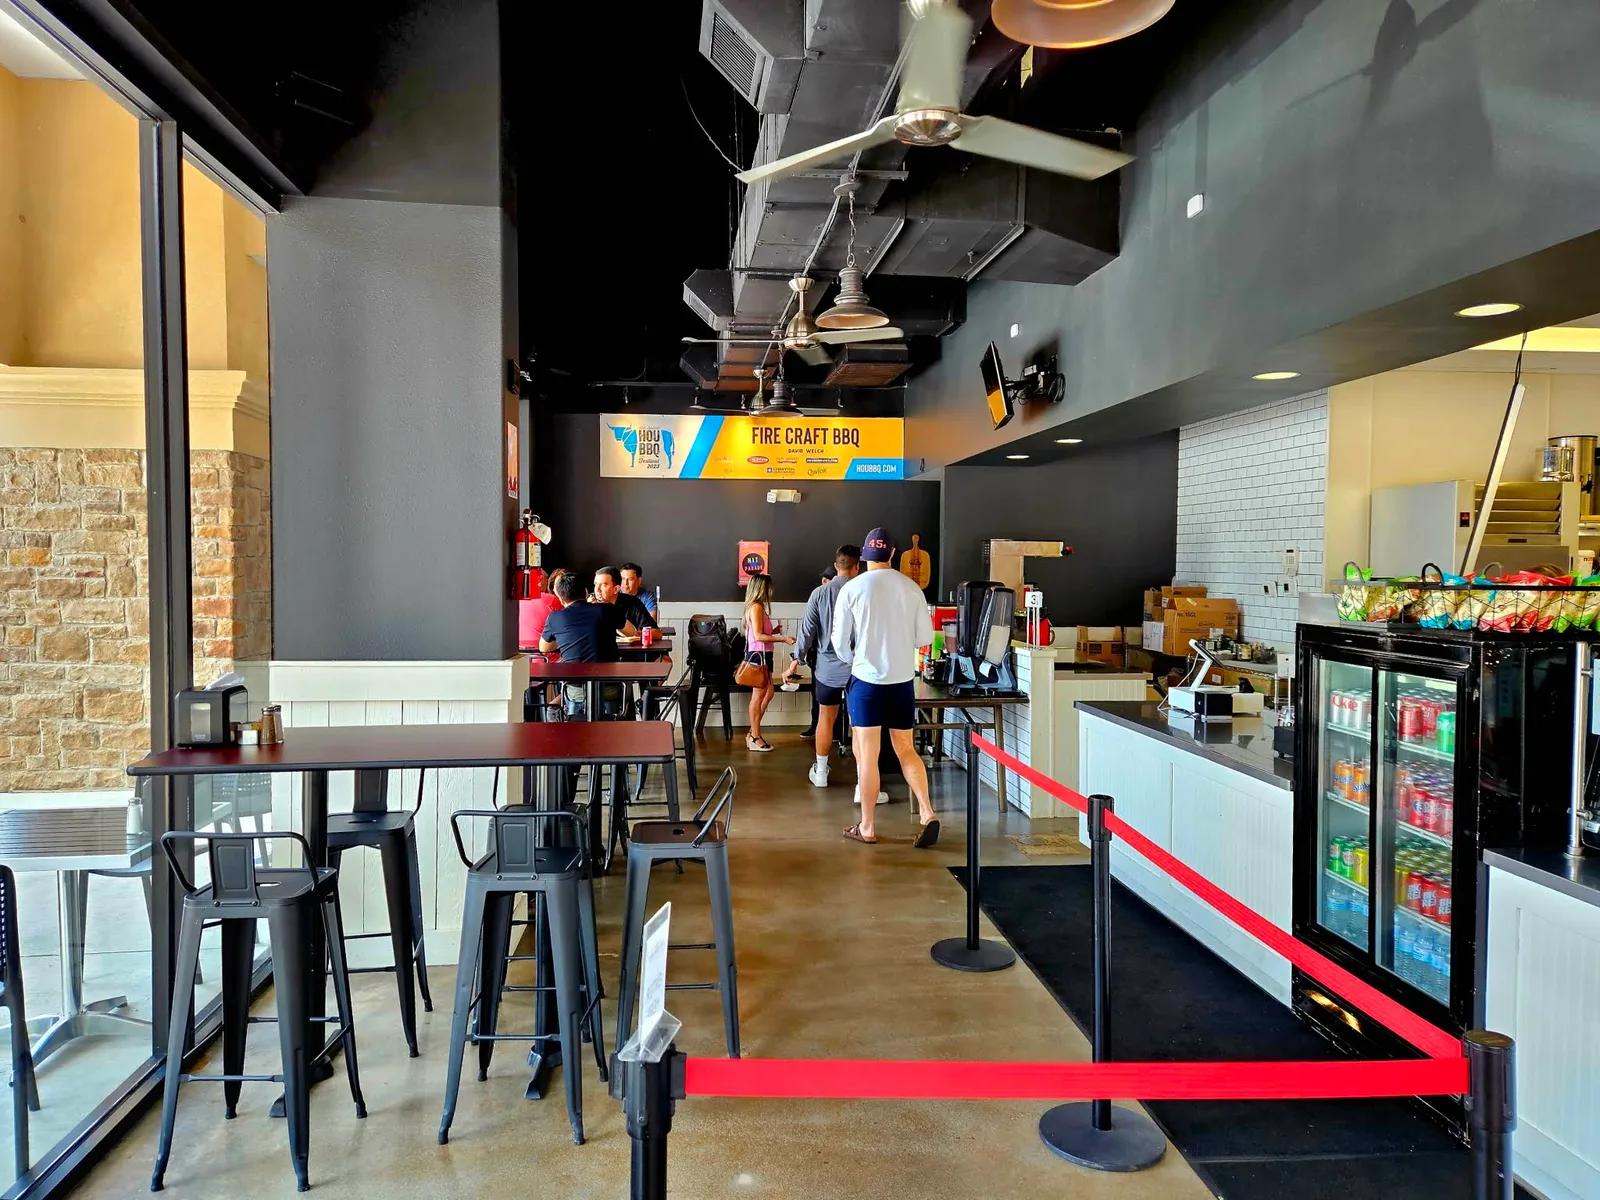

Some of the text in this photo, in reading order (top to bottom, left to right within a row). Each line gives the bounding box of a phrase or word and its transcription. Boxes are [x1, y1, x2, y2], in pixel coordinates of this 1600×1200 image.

[638, 429, 660, 442] HOU
[752, 427, 860, 448] FIRE CRAFT BBQ
[639, 443, 660, 458] BBQ
[856, 464, 897, 473] HOUBBQ.COM
